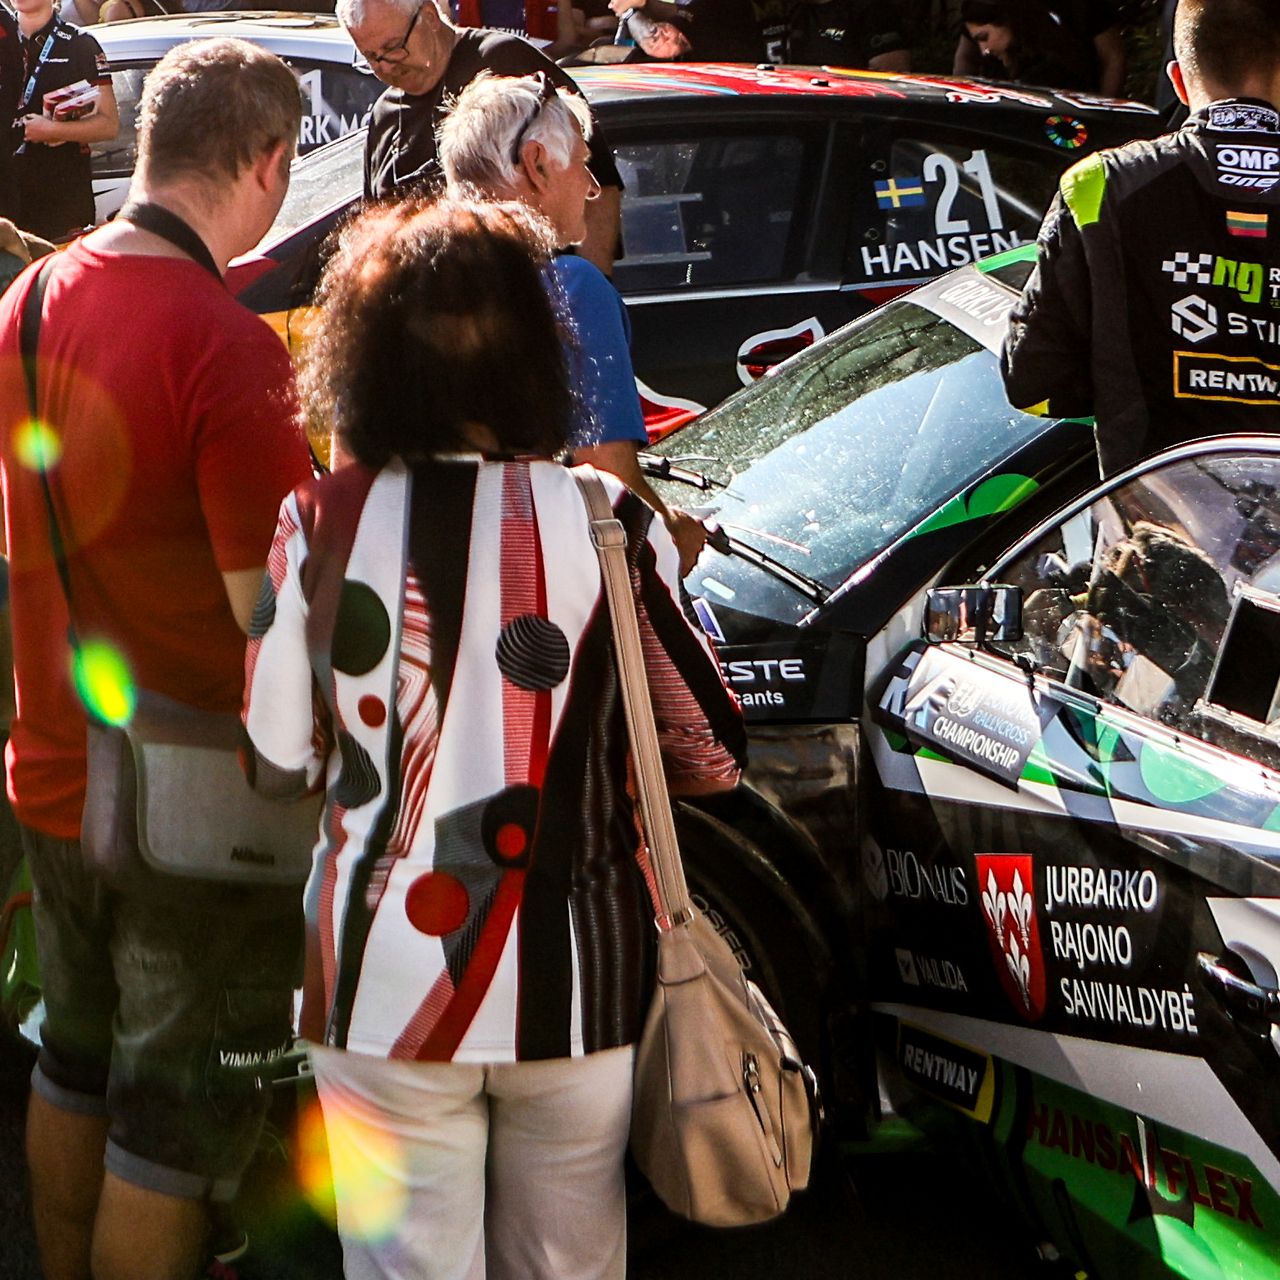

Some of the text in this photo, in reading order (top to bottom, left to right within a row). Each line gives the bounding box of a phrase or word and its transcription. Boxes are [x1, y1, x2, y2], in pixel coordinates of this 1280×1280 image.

[297, 114, 332, 145] RK
[1217, 149, 1280, 170] OMP
[923, 149, 1003, 235] 21
[1218, 174, 1280, 188] one
[860, 230, 1021, 276] HANSEN
[1189, 369, 1280, 397] RENTW
[719, 659, 805, 681] ESTE
[734, 689, 785, 705] cants
[933, 716, 1020, 769] CHAMPIONSHIP
[972, 711, 1031, 745] RALLYCROSS
[1045, 865, 1158, 912] JURBARKO
[1050, 920, 1133, 970] RAJONO
[1060, 977, 1199, 1034] SAVIVALDYBĖ
[903, 1043, 978, 1096] RENTWAY
